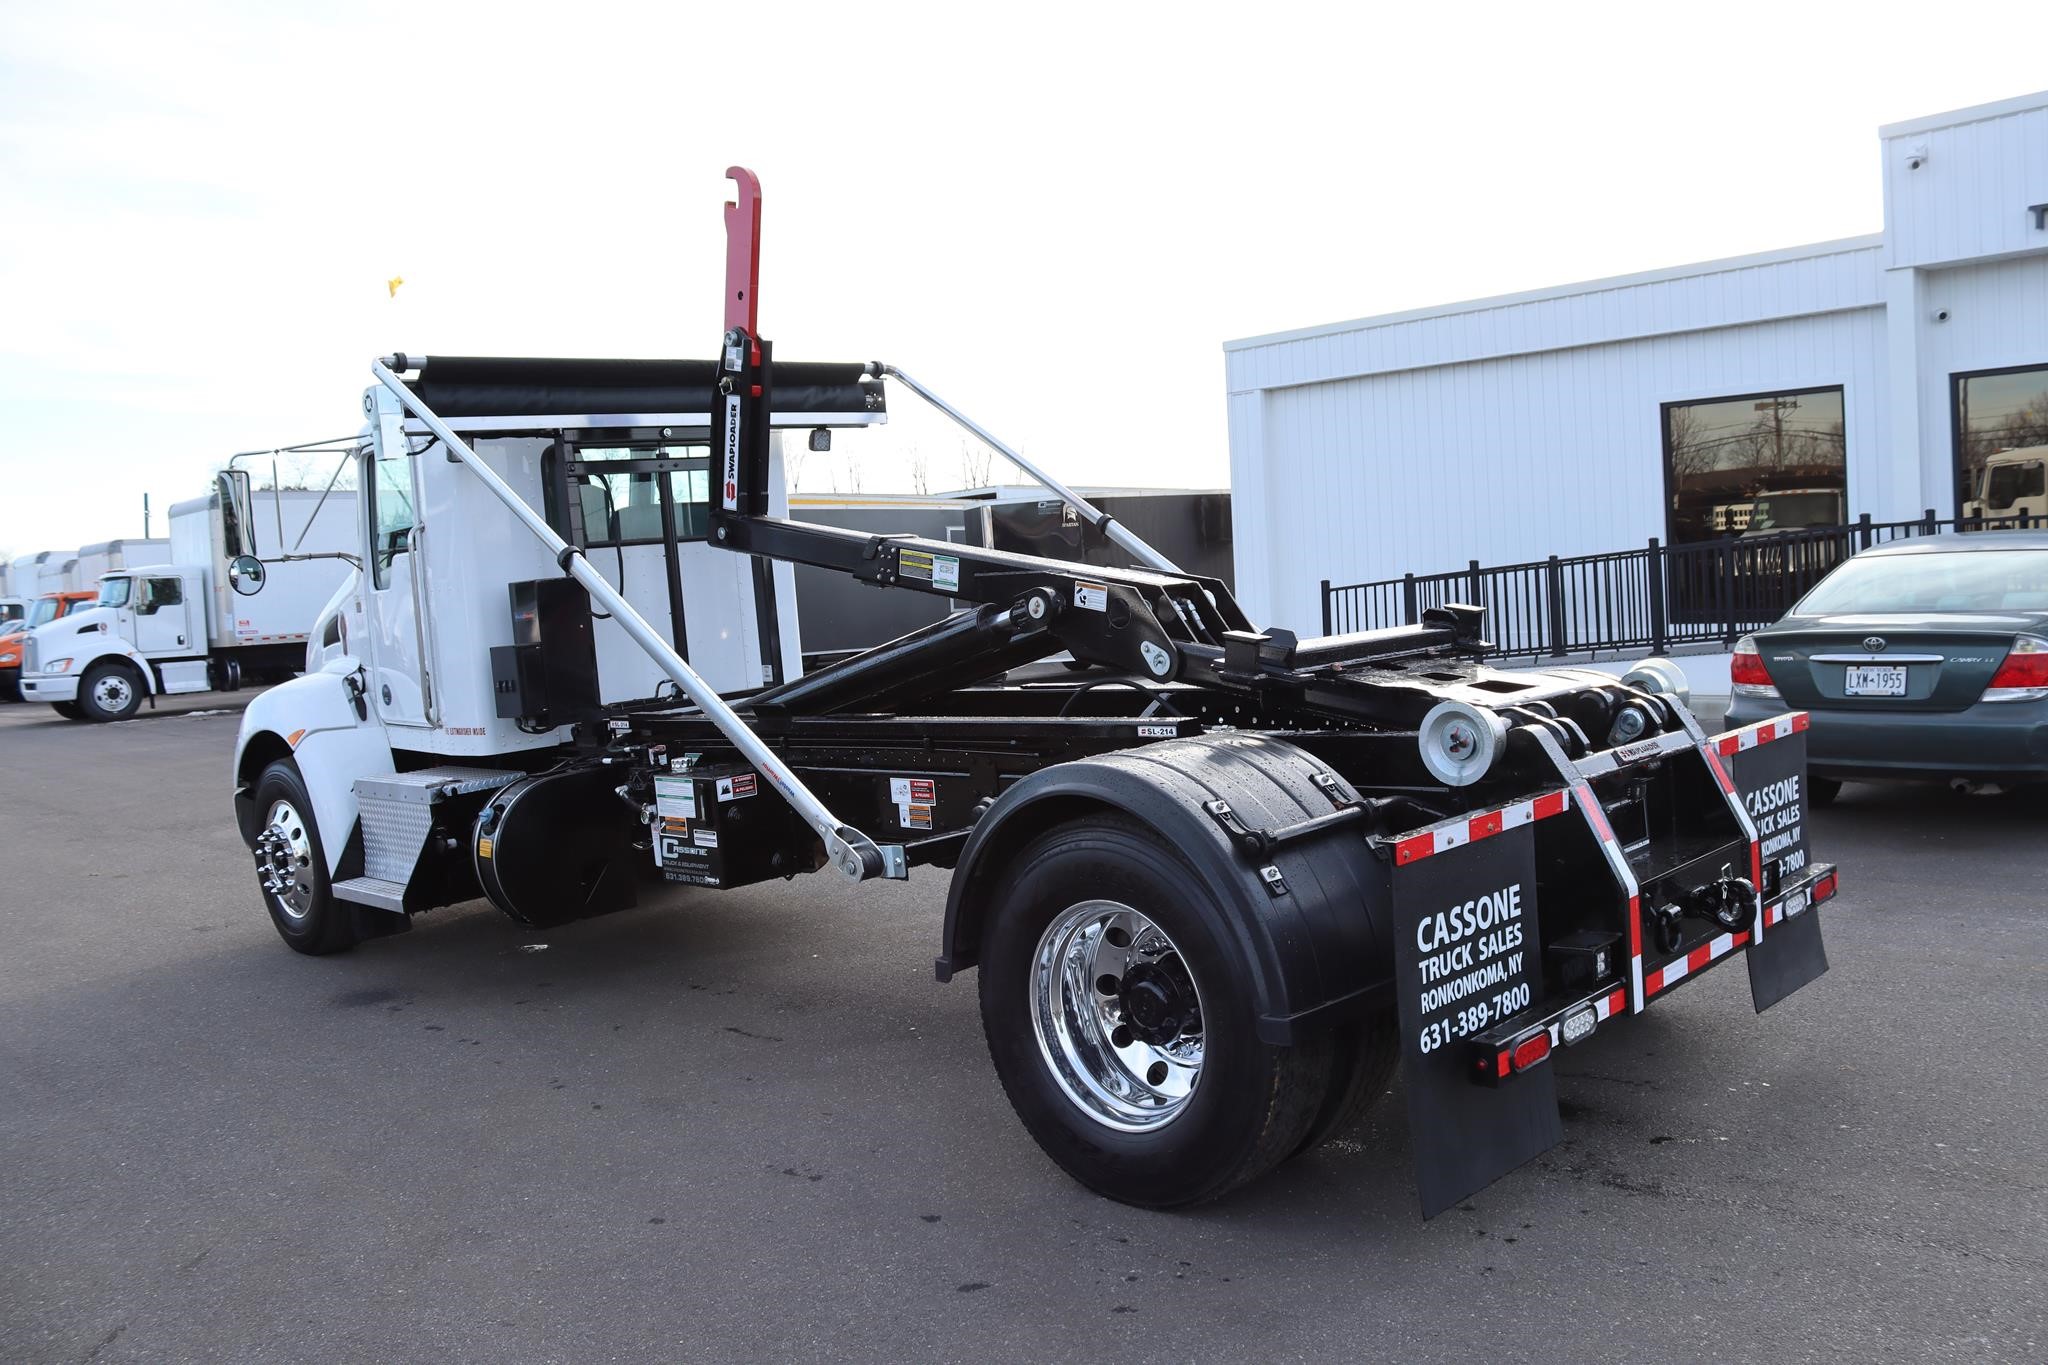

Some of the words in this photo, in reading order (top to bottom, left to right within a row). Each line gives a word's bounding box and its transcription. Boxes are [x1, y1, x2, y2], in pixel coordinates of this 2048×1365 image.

[728, 404, 737, 479] SWAPLOADER
[1746, 775, 1799, 816] CASSONE
[1757, 815, 1775, 837] UCK
[1777, 804, 1800, 829] SALES
[1761, 831, 1792, 858] KONKOMA,
[1792, 826, 1800, 844] NY
[1417, 884, 1522, 953] CASSONE
[1418, 942, 1474, 985] TRUCK
[1479, 923, 1523, 961] SALES
[1420, 960, 1508, 1014] RONKONKOMA,
[1508, 952, 1524, 978] NY
[1420, 982, 1530, 1054] 631-389-7800
